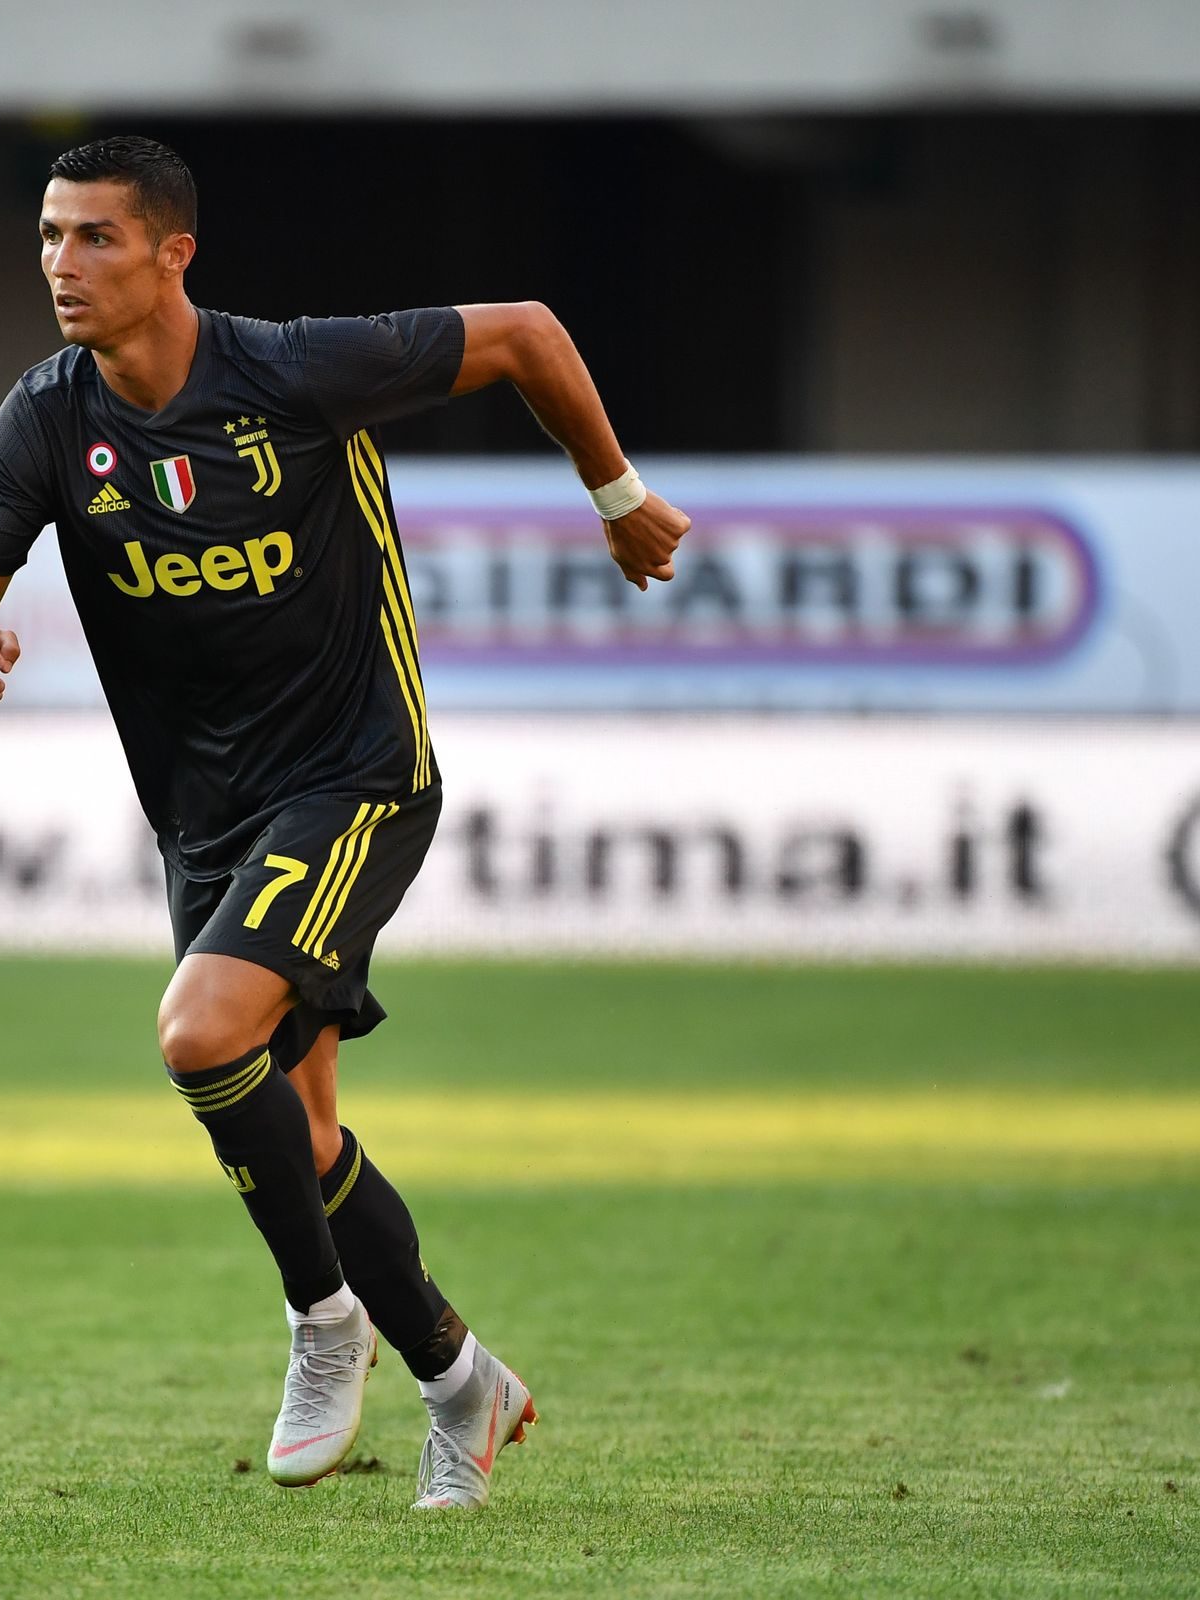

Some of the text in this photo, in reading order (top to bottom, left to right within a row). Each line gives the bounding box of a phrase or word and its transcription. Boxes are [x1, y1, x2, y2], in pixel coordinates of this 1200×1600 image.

[233, 429, 269, 447] JUVENTUS
[87, 500, 131, 515] adidas
[107, 531, 294, 598] Jeep
[243, 853, 310, 930] 7
